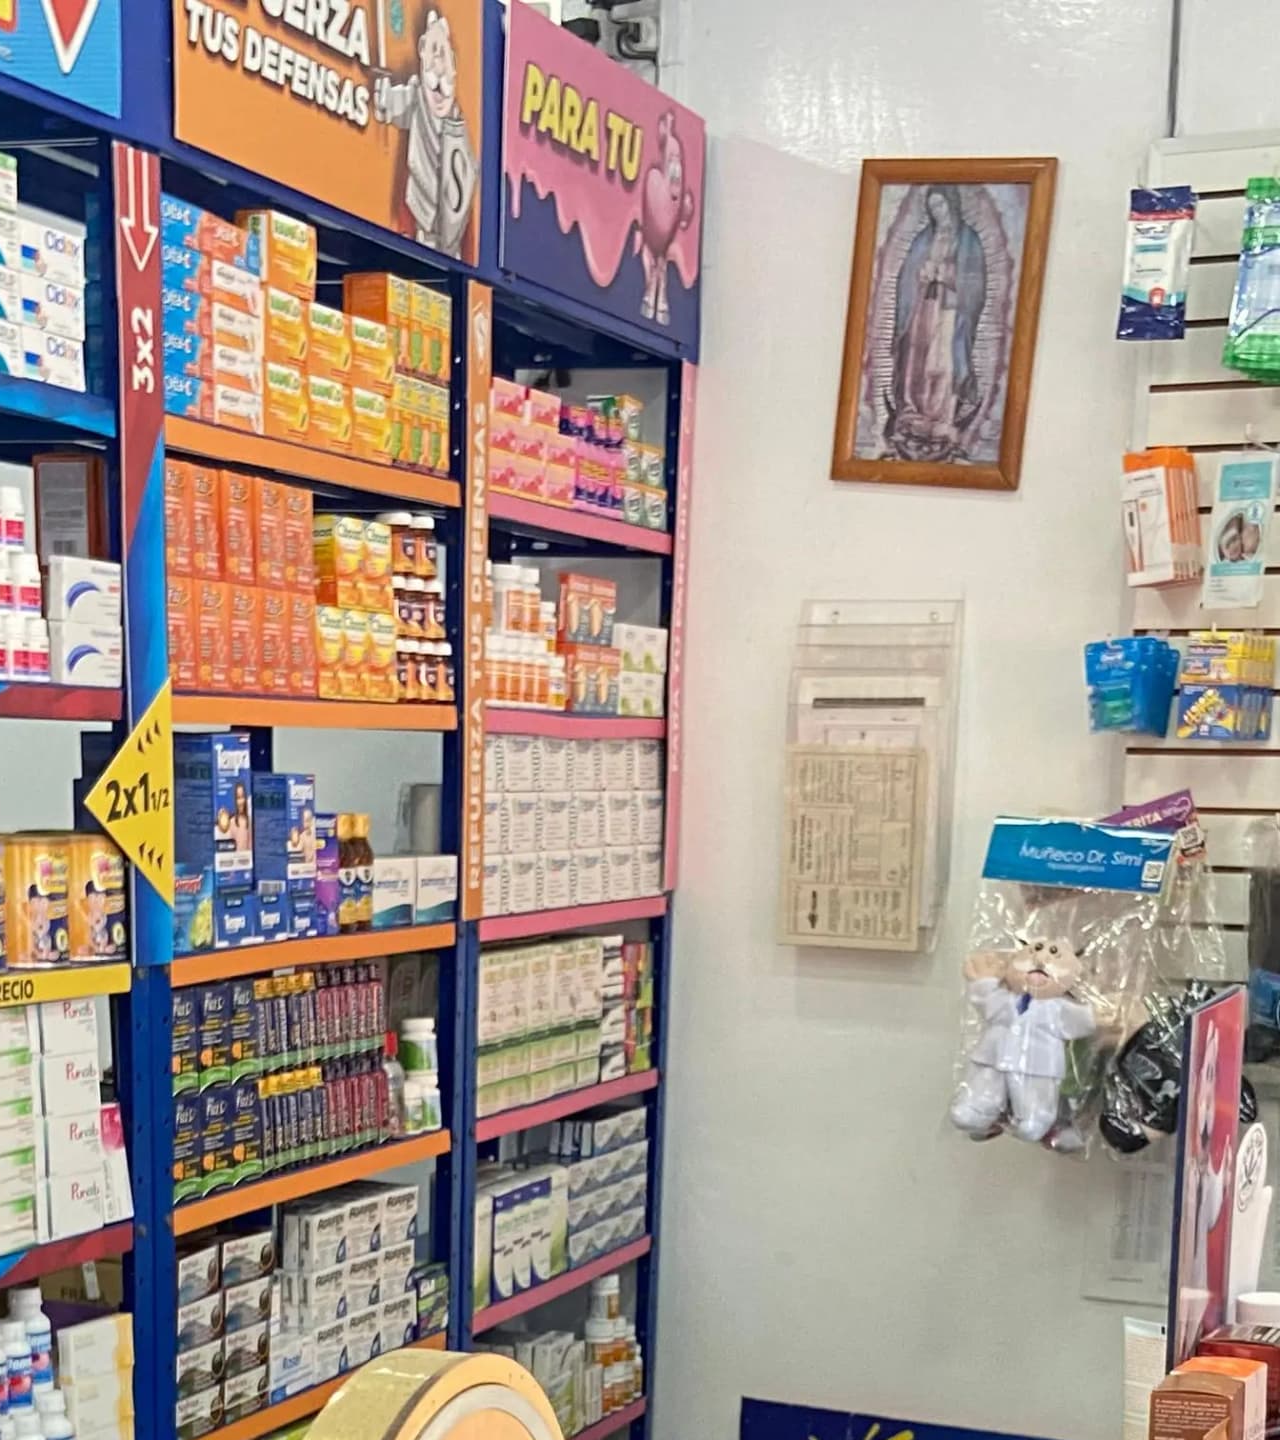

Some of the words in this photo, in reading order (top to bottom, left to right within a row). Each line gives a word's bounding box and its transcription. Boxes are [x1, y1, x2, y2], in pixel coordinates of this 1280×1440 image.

[185, 0, 240, 62] TUS
[242, 26, 370, 127] DEFENSAS
[522, 62, 600, 161] PARA
[606, 110, 644, 182] TU
[130, 306, 156, 393] 3x2
[470, 403, 486, 603] DEFENSAS
[469, 613, 484, 688] TUS
[468, 697, 484, 890] REFUERZA
[1019, 840, 1084, 865] Muñeco
[1087, 849, 1107, 864] Dr.
[1111, 851, 1144, 866] Simi
